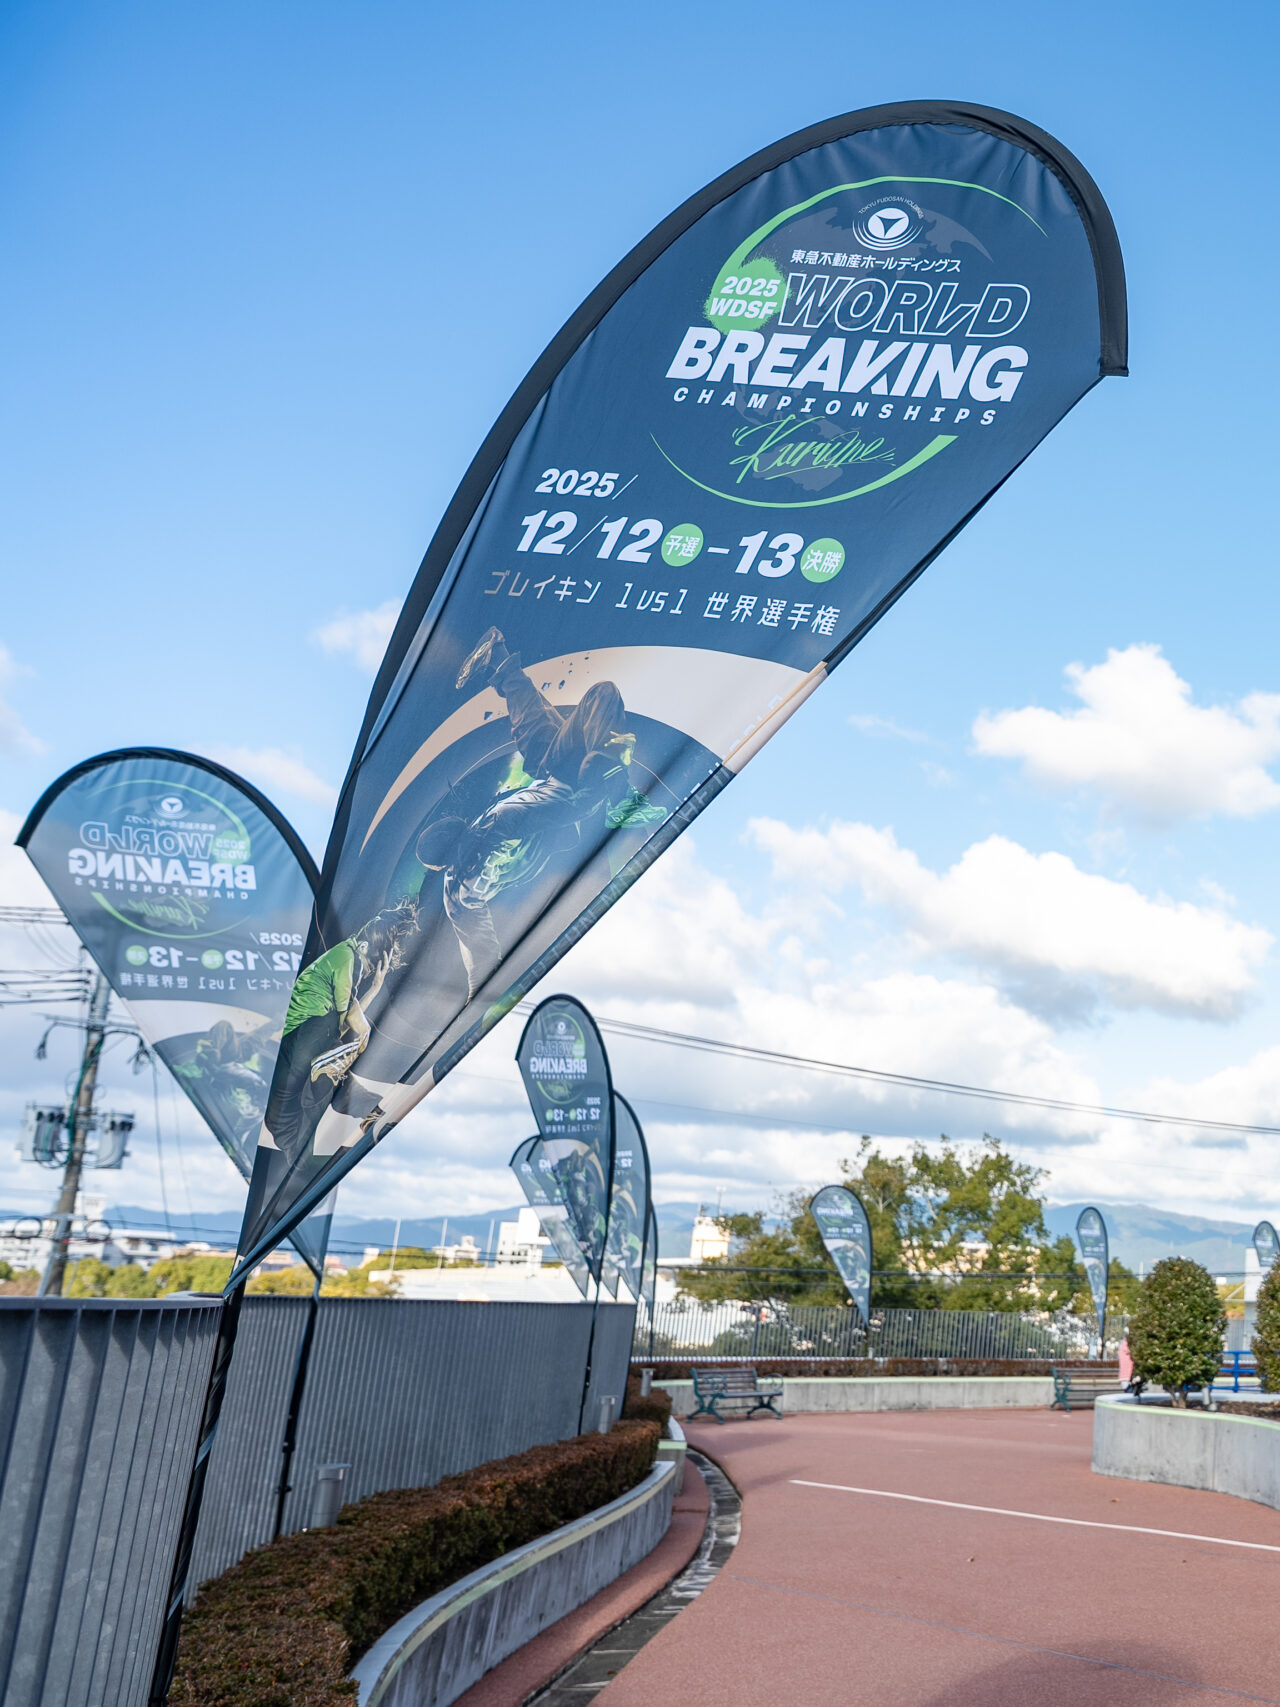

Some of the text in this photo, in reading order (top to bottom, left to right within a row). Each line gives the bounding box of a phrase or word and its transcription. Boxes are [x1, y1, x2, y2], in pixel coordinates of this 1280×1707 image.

[858, 201, 876, 214] TOKYU
[877, 196, 904, 204] FUDOSAN
[790, 249, 961, 273] 東急不動産ホールディングス
[720, 276, 781, 298] 2025
[778, 273, 1031, 338] WORLD
[709, 297, 777, 319] WDSF
[665, 327, 1029, 401] BREAKING
[672, 386, 996, 425] CHAMPIONSHIPS
[516, 510, 663, 563] 12/12
[665, 534, 699, 559] 予選
[802, 548, 842, 574] 決勝
[703, 592, 841, 636] 世界選手権
